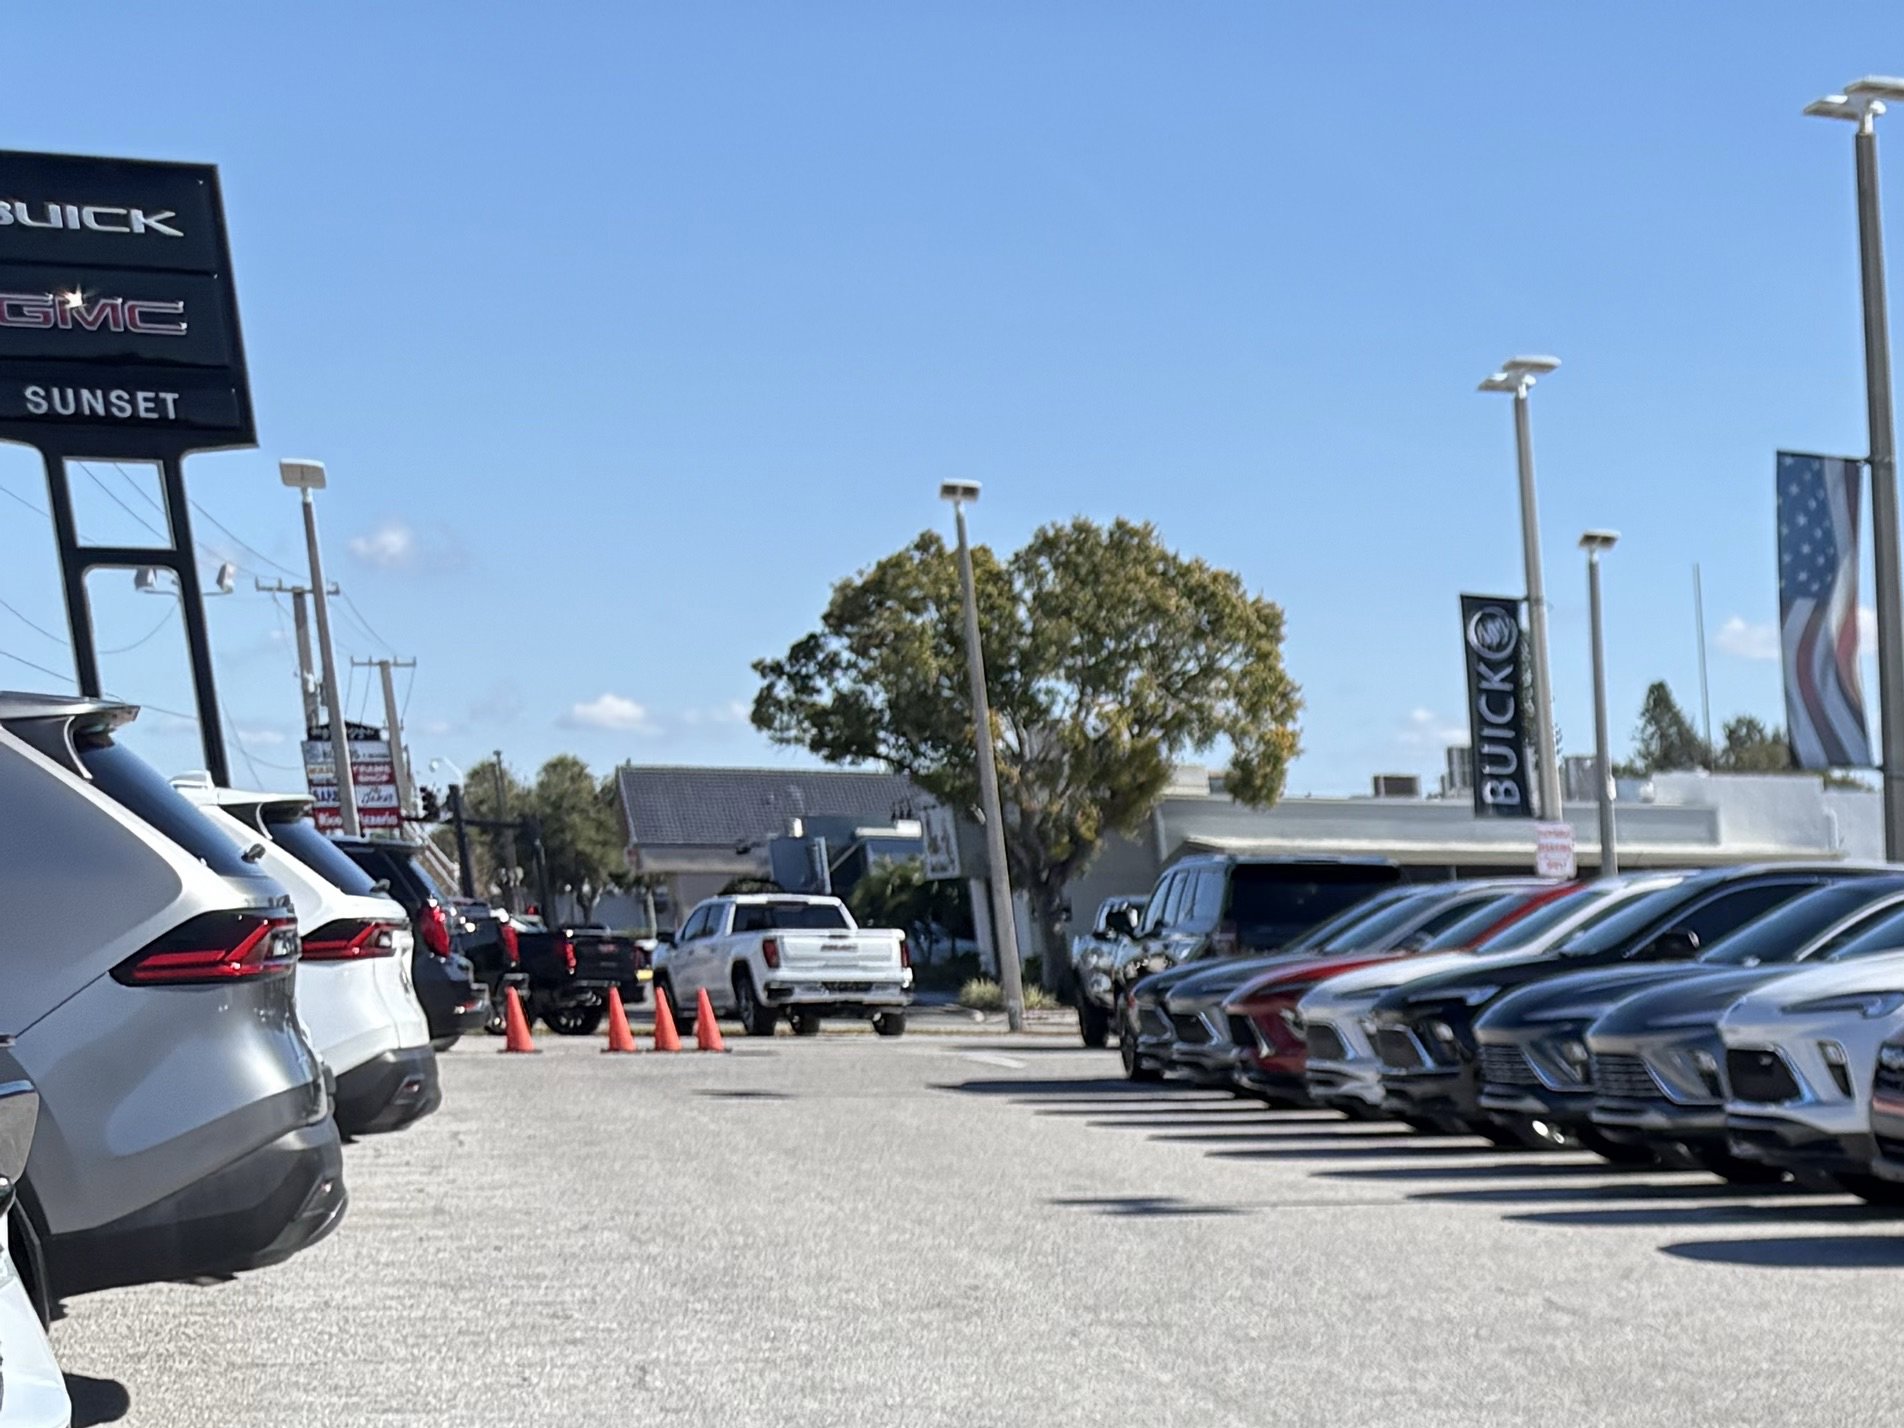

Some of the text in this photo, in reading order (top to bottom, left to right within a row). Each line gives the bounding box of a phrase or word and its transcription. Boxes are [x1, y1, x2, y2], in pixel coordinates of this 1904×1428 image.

[0, 292, 188, 336] GMC
[24, 385, 180, 420] SUNSET
[1476, 661, 1522, 806] BUICK
